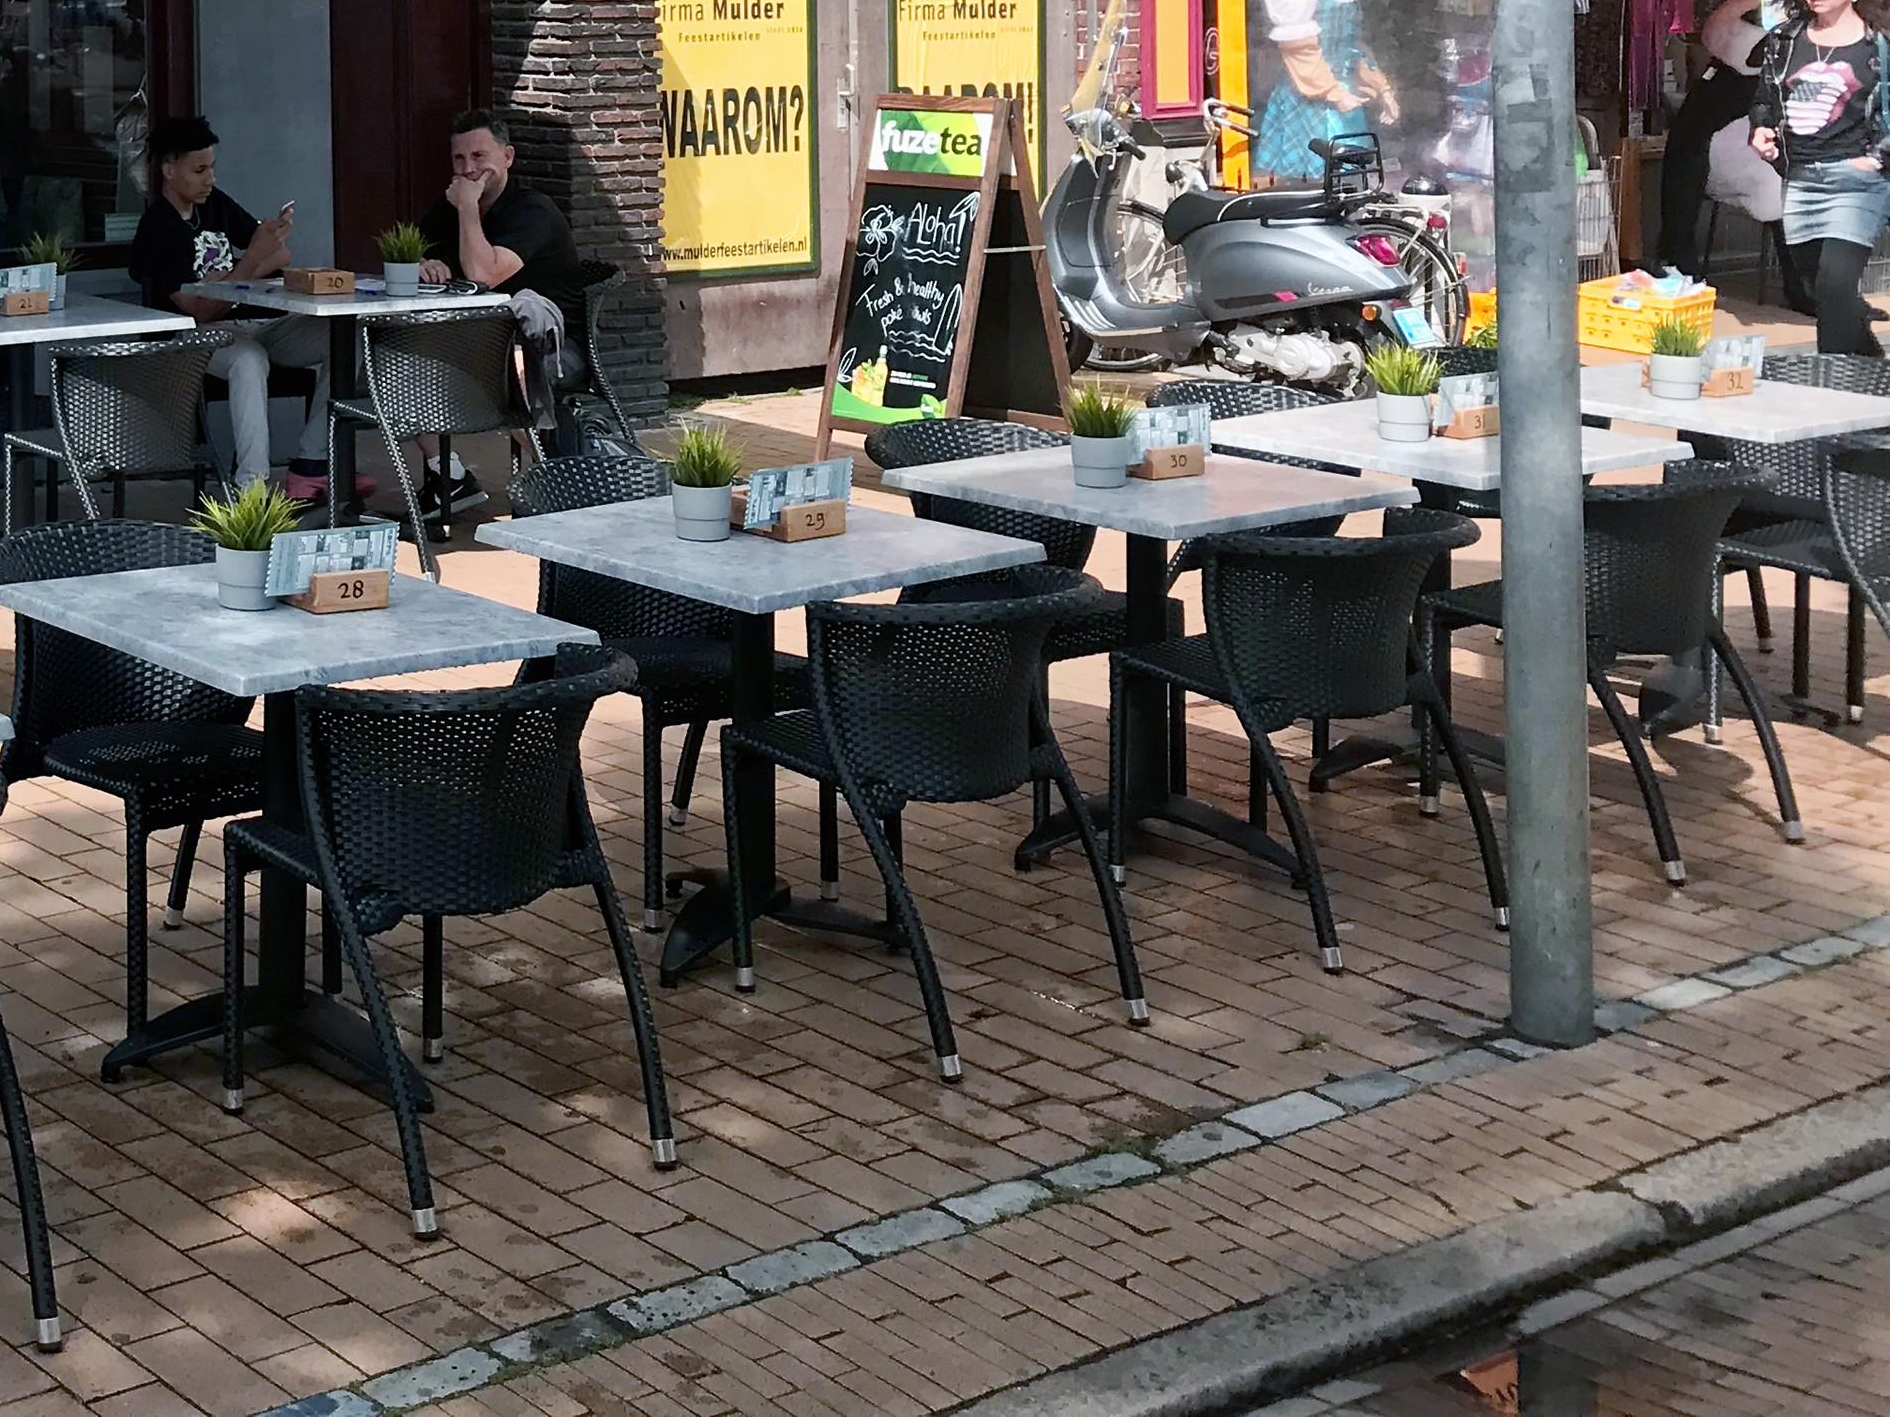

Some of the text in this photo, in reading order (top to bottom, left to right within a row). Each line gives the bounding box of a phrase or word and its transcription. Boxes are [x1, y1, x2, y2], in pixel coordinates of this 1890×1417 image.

[678, 31, 761, 43] Feestartikelen
[922, 29, 996, 41] Feestartikelen
[326, 276, 344, 289] 20
[1307, 281, 1354, 297] Vespa
[855, 272, 945, 317] Fresh & healthy
[19, 297, 33, 309] 21
[1726, 371, 1744, 391] 32
[1474, 413, 1486, 430] 31
[1169, 453, 1188, 469] 30
[805, 511, 826, 531] 29
[337, 579, 366, 601] 28
